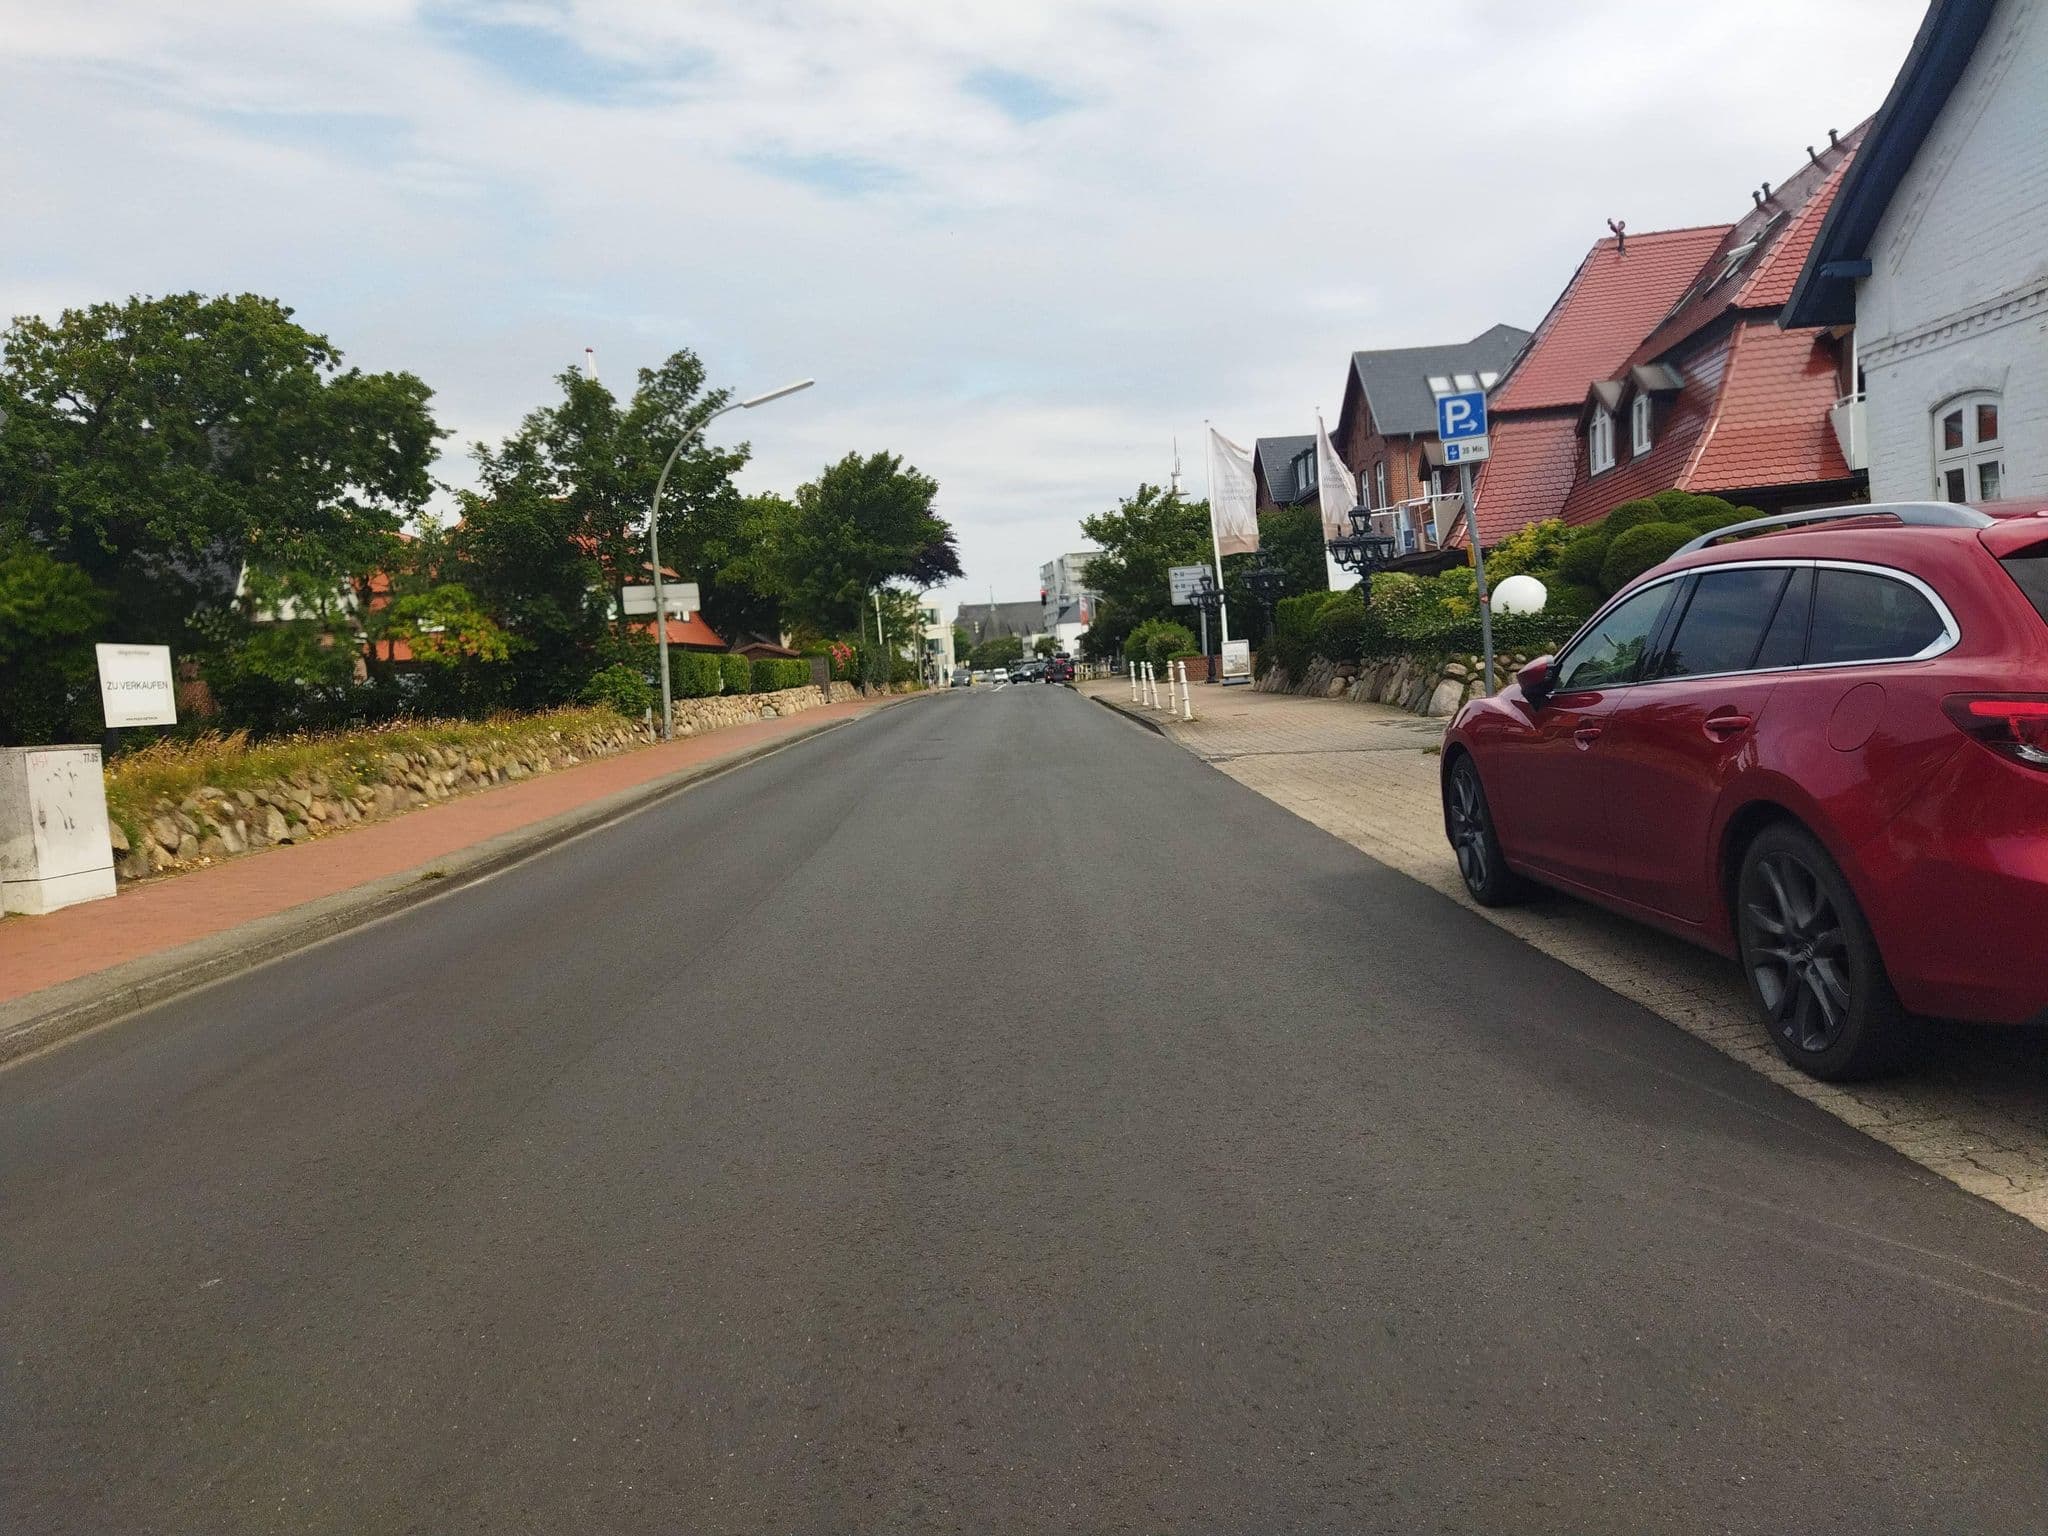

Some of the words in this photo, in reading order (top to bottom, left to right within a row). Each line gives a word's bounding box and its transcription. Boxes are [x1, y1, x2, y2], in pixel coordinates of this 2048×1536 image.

[1445, 399, 1471, 434] P
[106, 681, 118, 690] ZU
[120, 680, 168, 690] VERKAUFEN
